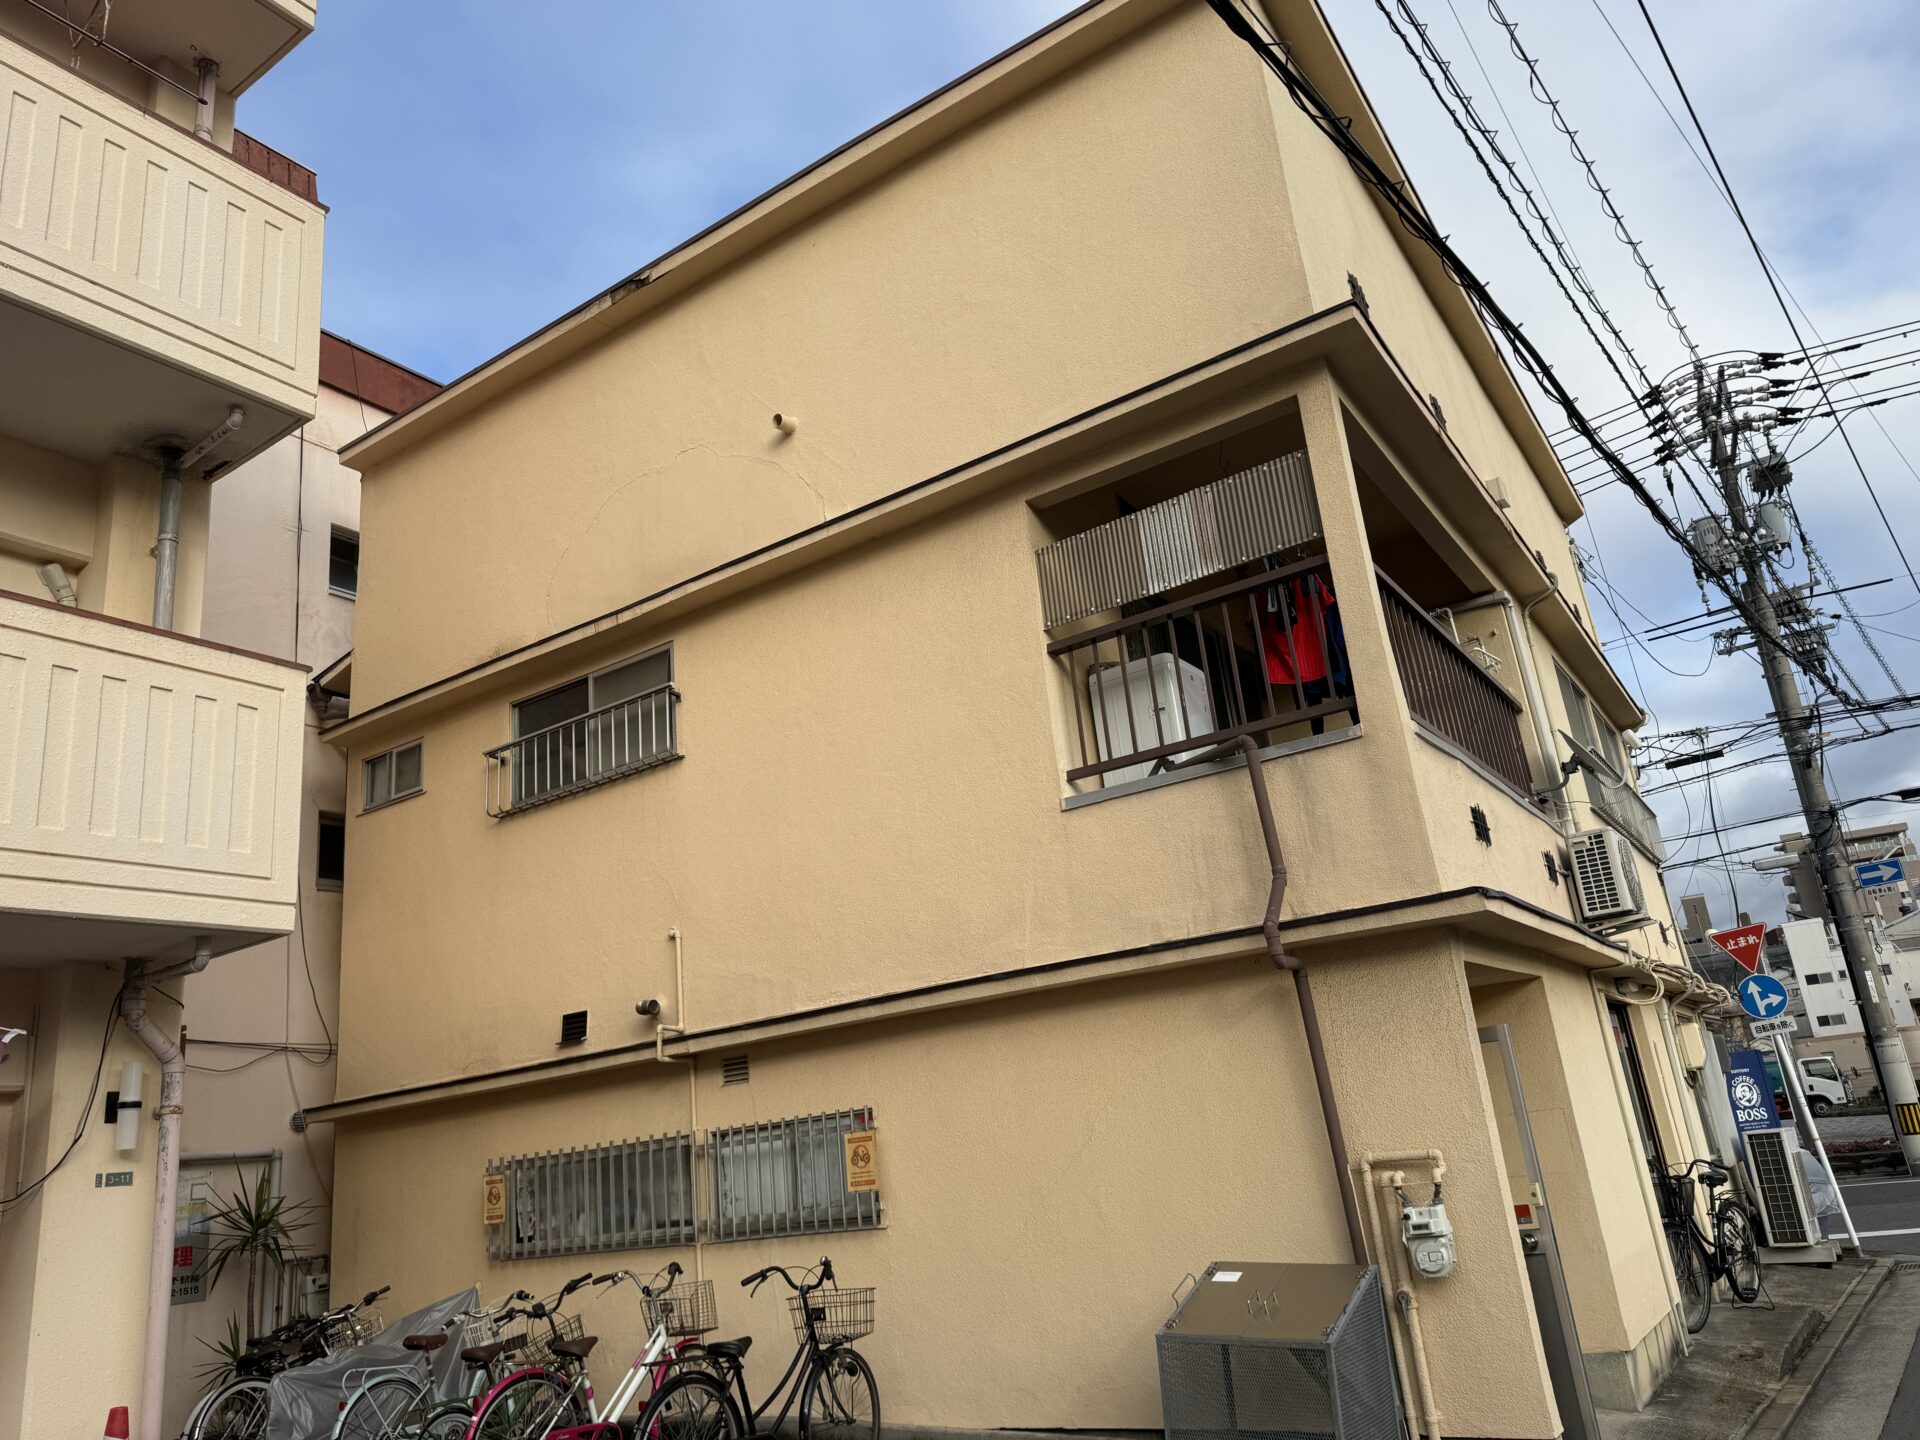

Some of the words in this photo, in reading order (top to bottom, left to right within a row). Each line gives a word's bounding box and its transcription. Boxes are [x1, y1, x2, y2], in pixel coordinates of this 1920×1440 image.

[1727, 934, 1760, 950] 止まれ
[1754, 1020, 1795, 1034] 自転車を除く
[1731, 1075, 1755, 1087] COFFEE
[1736, 1107, 1768, 1122] BOSS
[109, 1174, 130, 1184] 3-11
